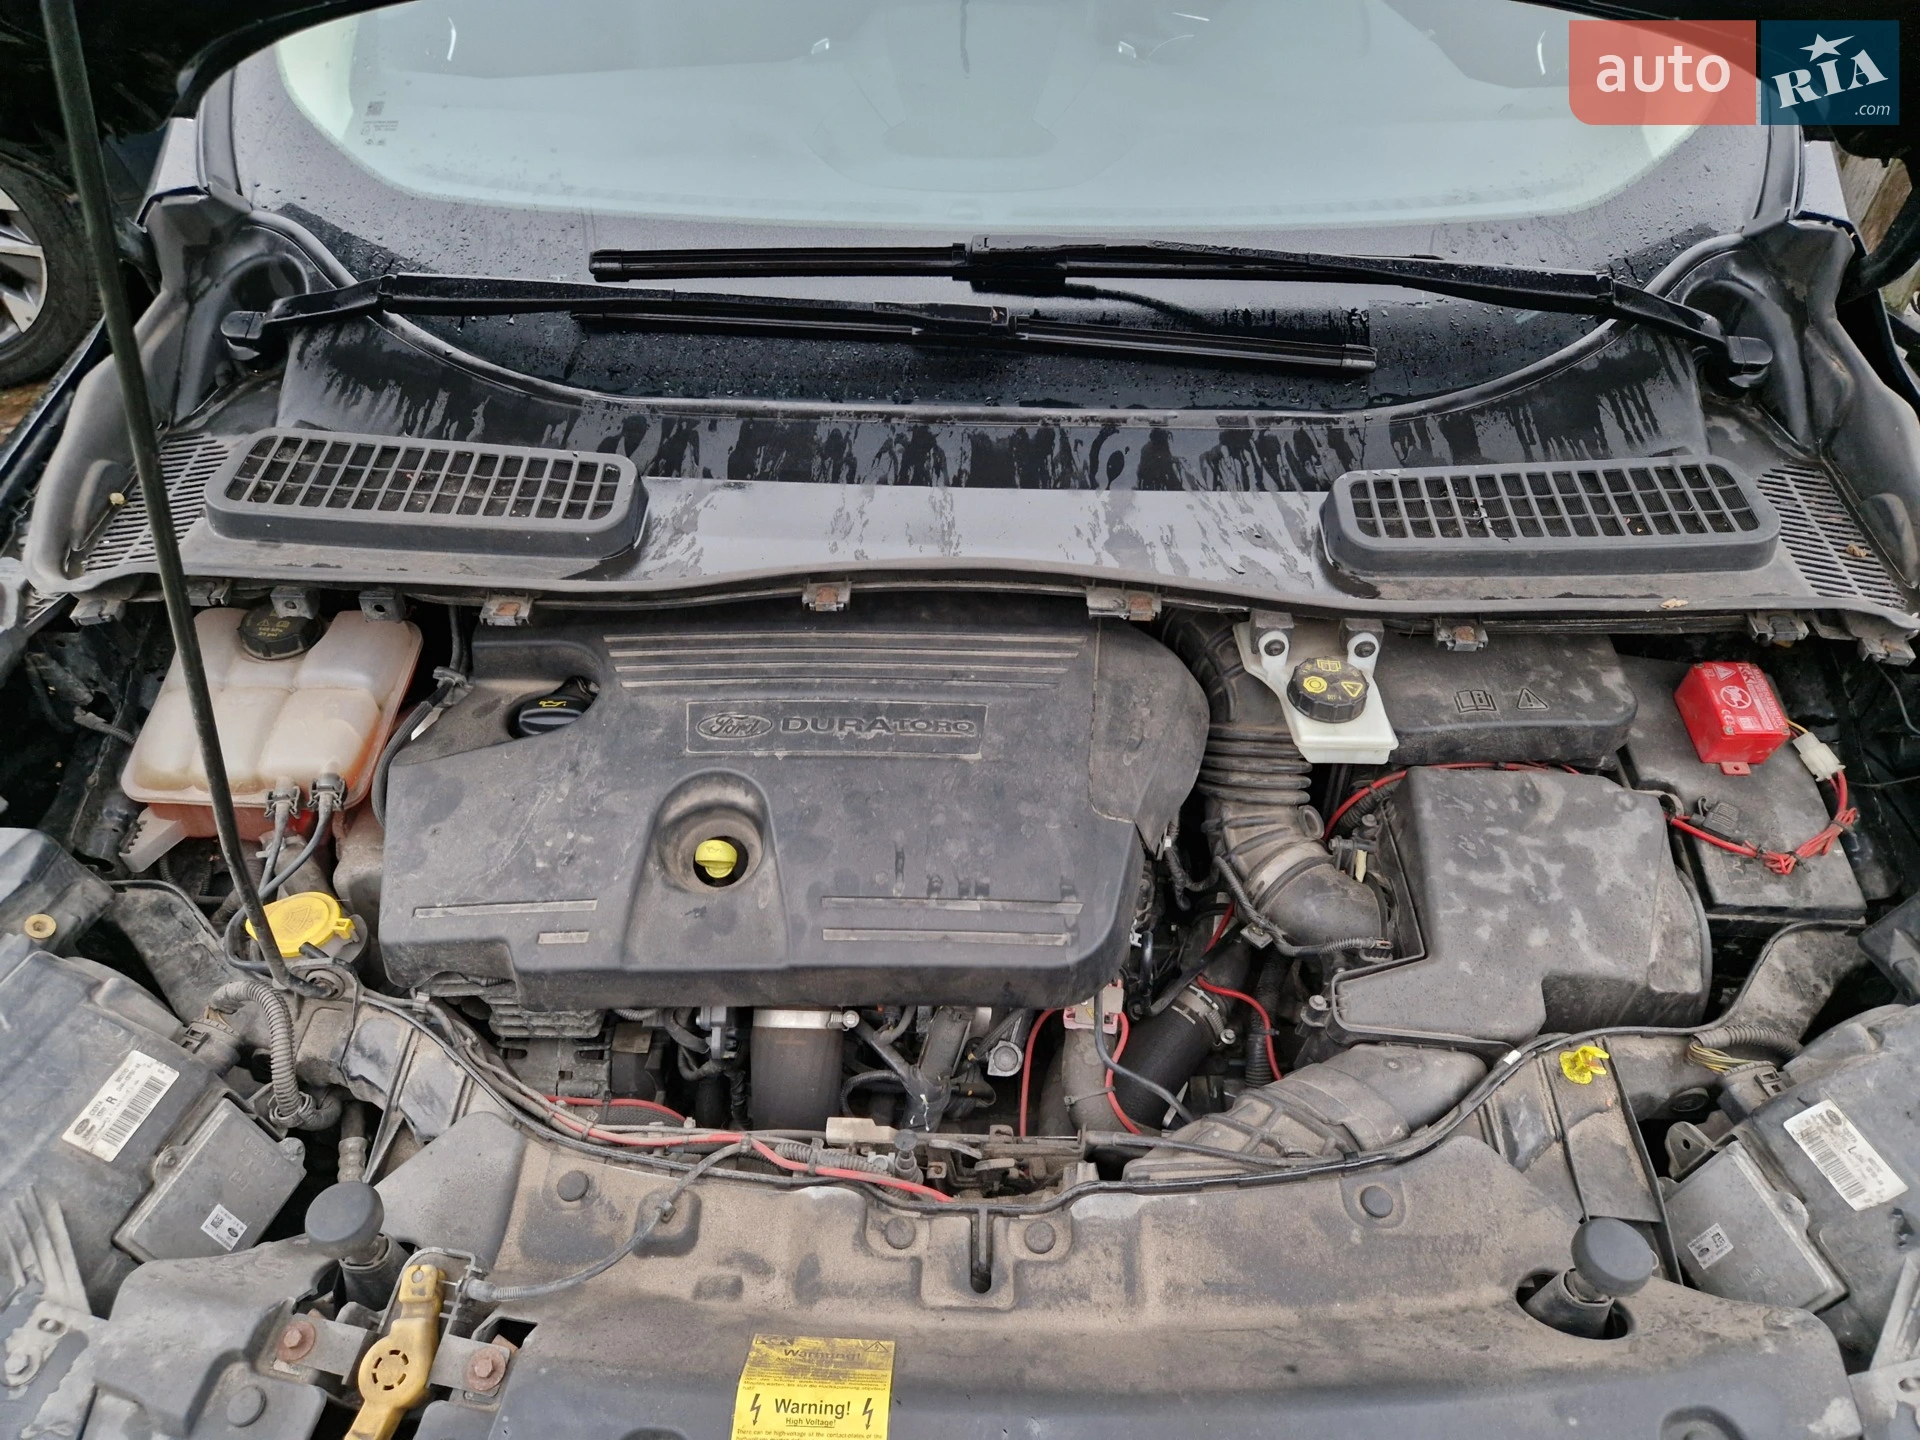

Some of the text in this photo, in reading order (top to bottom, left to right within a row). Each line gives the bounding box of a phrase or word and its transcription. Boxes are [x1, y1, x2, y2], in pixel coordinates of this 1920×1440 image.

[705, 713, 766, 737] Ford
[105, 1095, 118, 1105] R
[1847, 1146, 1857, 1154] L
[774, 1398, 852, 1420] Warning!
[785, 1417, 837, 1428] High Voltage!
